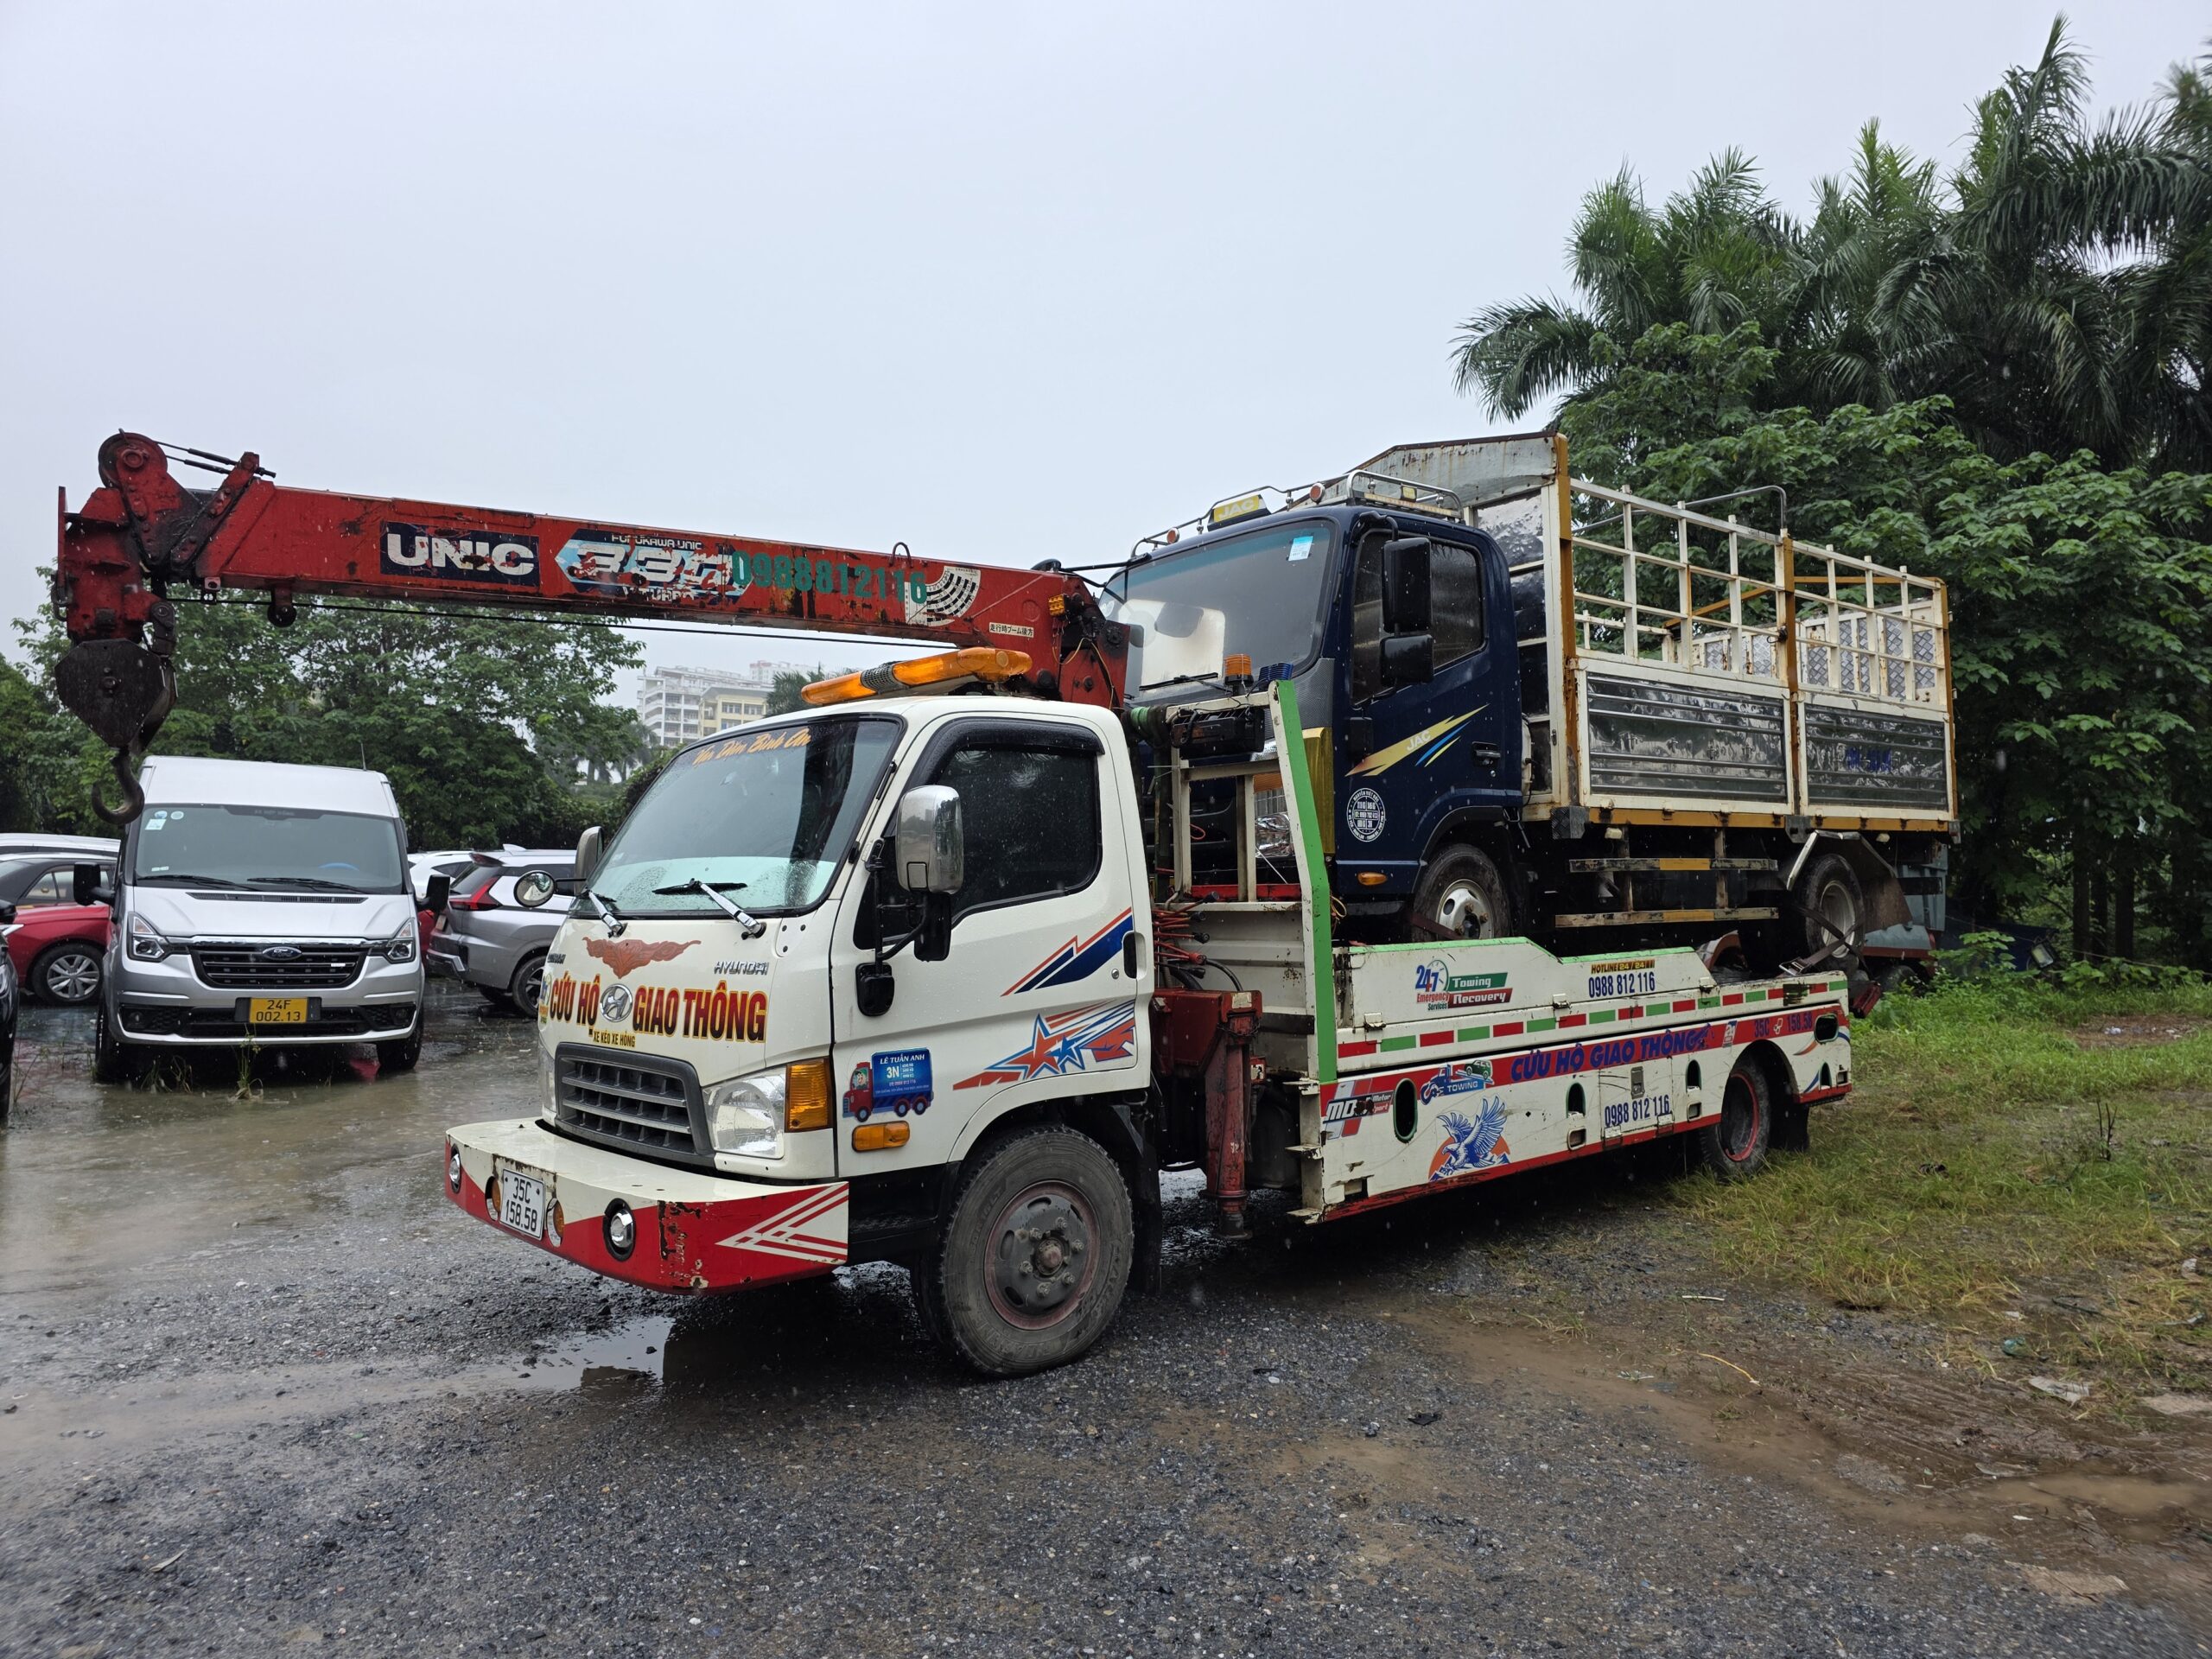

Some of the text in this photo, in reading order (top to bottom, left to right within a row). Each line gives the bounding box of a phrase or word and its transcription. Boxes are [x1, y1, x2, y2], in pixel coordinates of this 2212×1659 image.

[1217, 498, 1254, 518] JAC
[677, 540, 702, 550] UNIC
[386, 533, 535, 576] UNIC
[732, 551, 927, 604] 0988812116
[1406, 730, 1432, 752] JAC
[714, 960, 770, 976] HYUNDAI
[1591, 963, 1618, 975] HOTLINE
[1452, 976, 1491, 988] Towing
[1589, 971, 1656, 998] 0988 812 116
[1417, 992, 1450, 1002] Emergency
[1453, 992, 1507, 1004] Recovery
[267, 1000, 292, 1010] 24F
[550, 970, 577, 1023] CỨU
[576, 974, 601, 1037] HỘ
[632, 985, 681, 1037] GIAO
[683, 980, 767, 1043] THÔNG
[1427, 1002, 1447, 1011] Services
[256, 1011, 301, 1021] 002.13
[1754, 1019, 1770, 1038] 35C
[593, 1031, 600, 1043] XE
[612, 1033, 619, 1046] XE
[880, 1056, 889, 1065] LÊ
[1511, 1028, 1696, 1082] CỨU HỘ GIAO THÔNG
[887, 1066, 899, 1078] 3N
[1447, 1081, 1478, 1092] TOWING
[1604, 1094, 1670, 1128] 0988 812 116
[512, 1177, 532, 1204] 35C
[505, 1199, 538, 1232] 158.58
